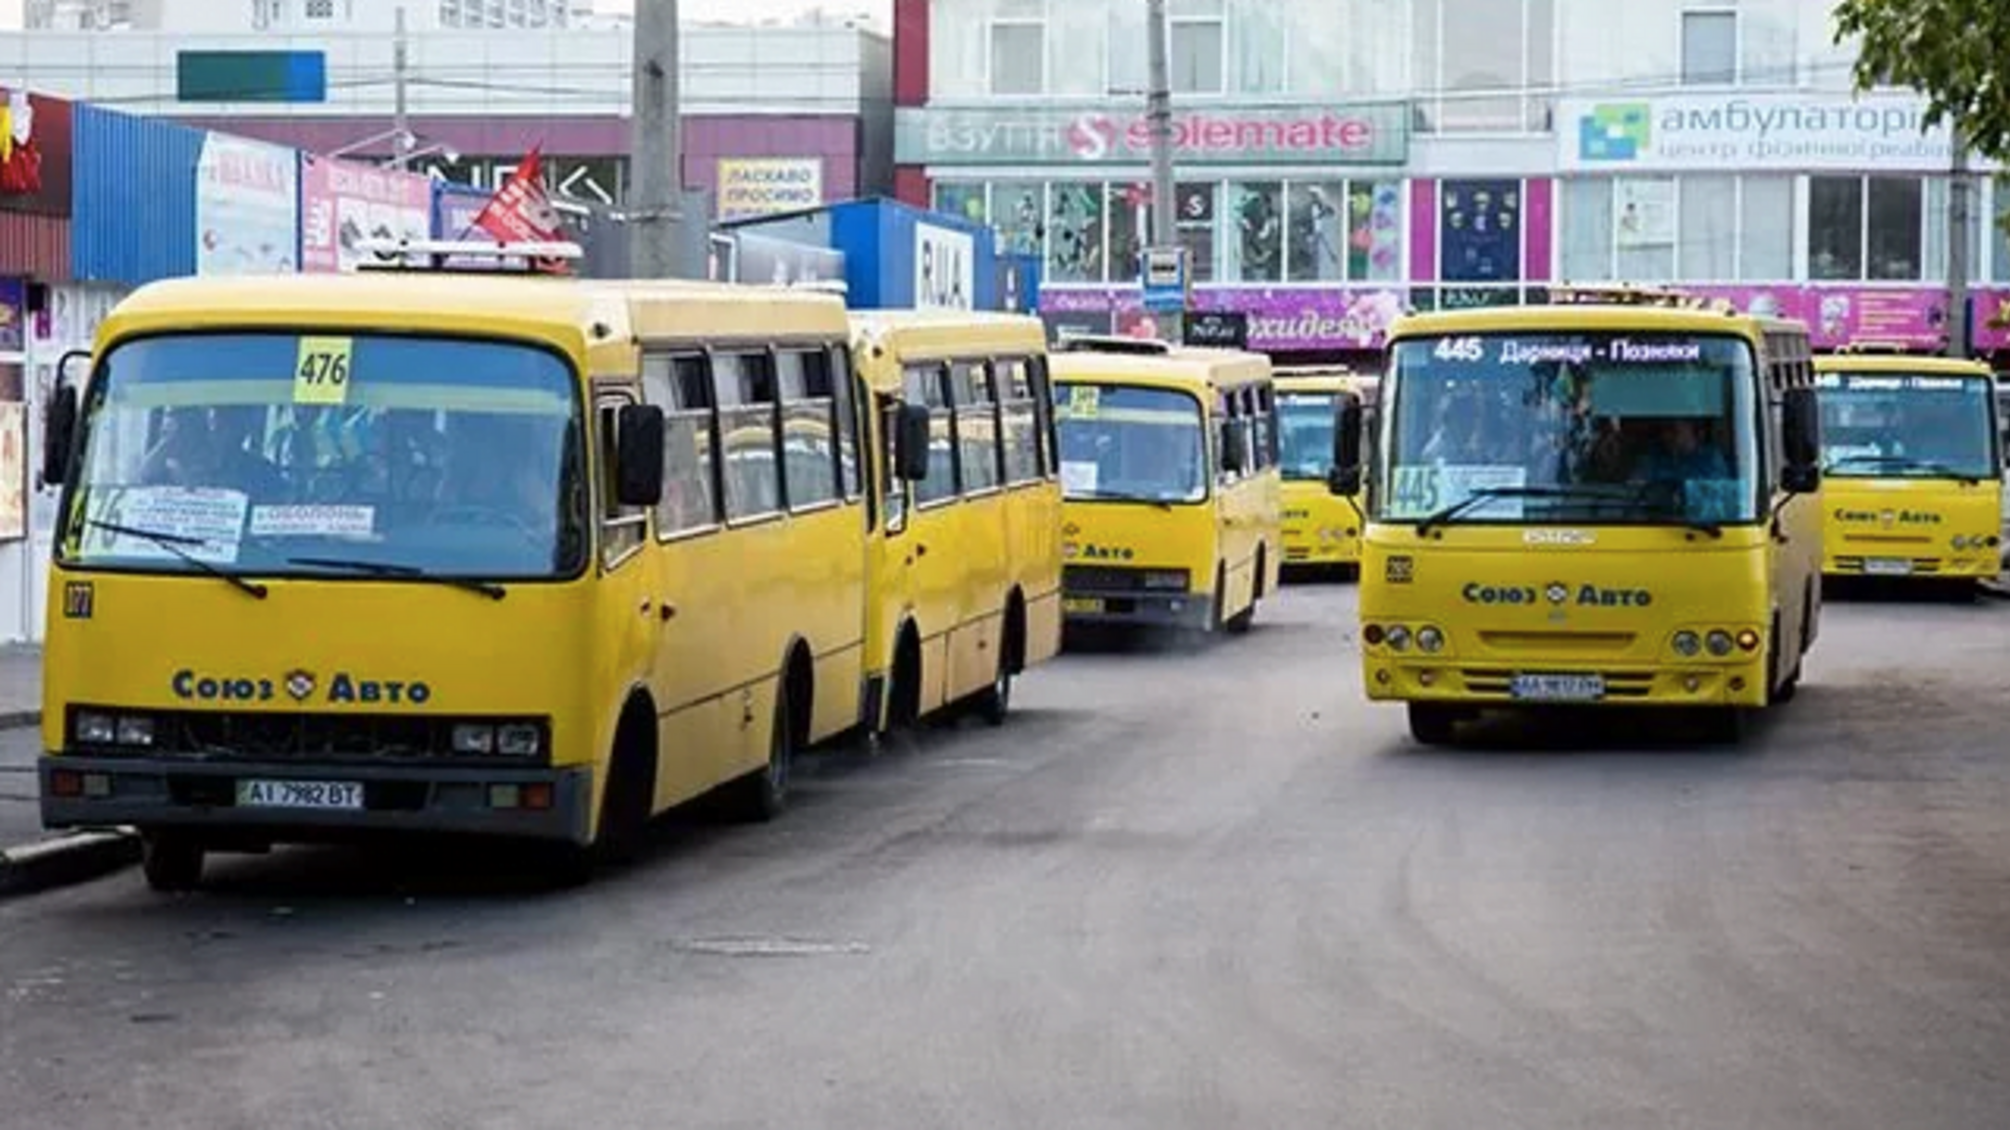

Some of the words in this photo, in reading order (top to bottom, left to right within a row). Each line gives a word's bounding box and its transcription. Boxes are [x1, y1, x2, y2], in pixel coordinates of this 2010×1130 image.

[1660, 101, 1918, 136] амбулаторі
[1434, 338, 1483, 361] 445
[1500, 340, 1591, 364] Дарниця
[1610, 339, 1700, 360] Позняки
[300, 353, 346, 385] 476
[1395, 469, 1438, 512] 445
[1083, 545, 1135, 561] Авто
[1463, 582, 1536, 604] Союз
[1576, 583, 1653, 607] Авто
[172, 669, 274, 701] Союз
[327, 673, 431, 704] Авто
